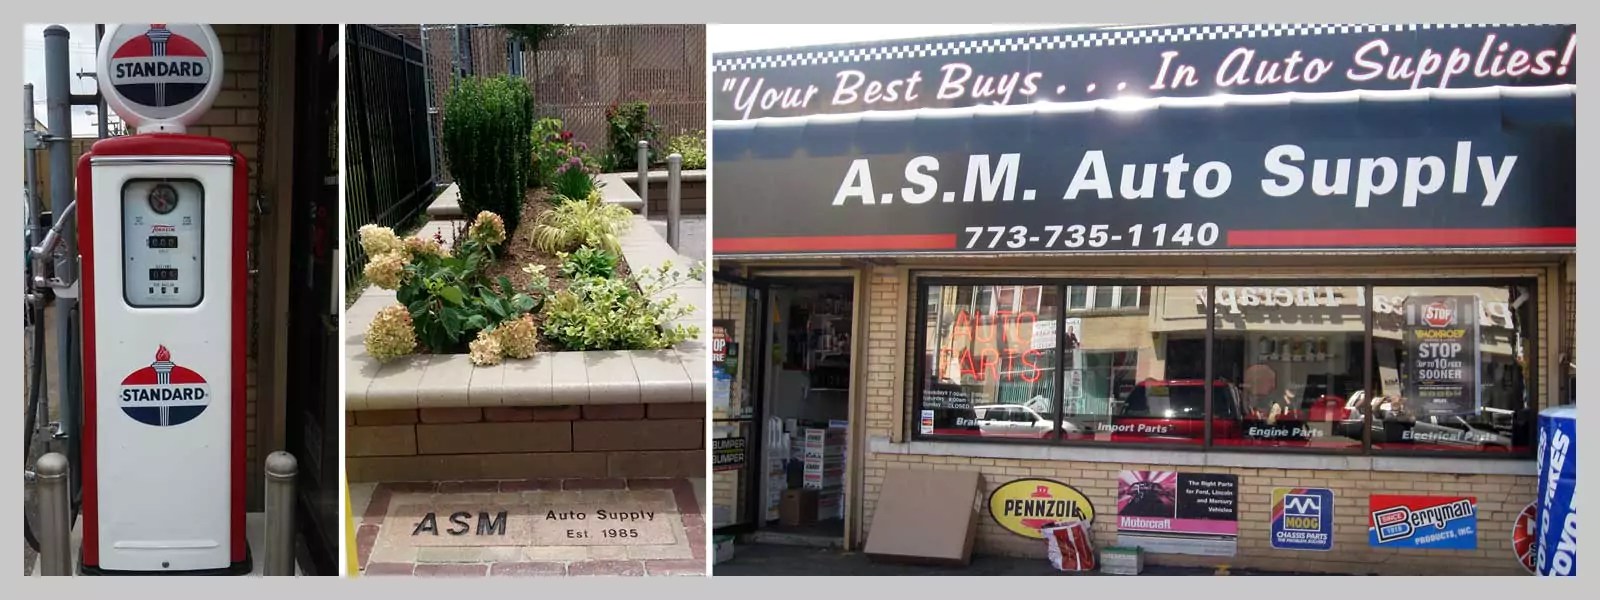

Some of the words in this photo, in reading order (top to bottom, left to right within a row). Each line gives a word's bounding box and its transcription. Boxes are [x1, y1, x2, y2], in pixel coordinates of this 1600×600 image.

[116, 62, 204, 78] STANDARD
[830, 69, 922, 106] Best
[936, 62, 1044, 107] Buys
[1149, 51, 1199, 91] In
[1214, 47, 1334, 87] Auto
[1346, 34, 1576, 90] Supplies!
[832, 152, 1037, 206] A.S.M.
[1063, 150, 1232, 200] Auto
[1261, 140, 1518, 208] Supply
[964, 221, 1220, 249] 773-735-1140
[1426, 306, 1453, 320] STOP
[952, 310, 1038, 346] AUTO
[1418, 342, 1462, 359] STOP
[938, 346, 1042, 382] PARTS
[1434, 358, 1447, 370] 10
[1418, 369, 1462, 379] SOONER
[123, 387, 205, 402] STANDARD
[1097, 422, 1135, 433] Import
[1137, 424, 1168, 434] Parts
[1249, 427, 1289, 438] Engine
[1291, 428, 1324, 438] Parts
[1402, 430, 1461, 440] Electrical
[1465, 431, 1497, 441] Parts
[545, 509, 587, 521] Auto
[597, 508, 656, 522] Supply
[1004, 499, 1079, 518] PENNZOIL
[412, 510, 509, 537] ASM
[1121, 516, 1171, 529] Motorcraft
[1285, 516, 1319, 529] MOOG
[1373, 499, 1472, 542] Berryman
[1381, 512, 1402, 522] SINCE
[602, 528, 639, 539] 1985
[1276, 531, 1305, 539] CHASSIS
[1306, 533, 1328, 541] PARTS
[1415, 530, 1457, 545] PRODUCTS,
